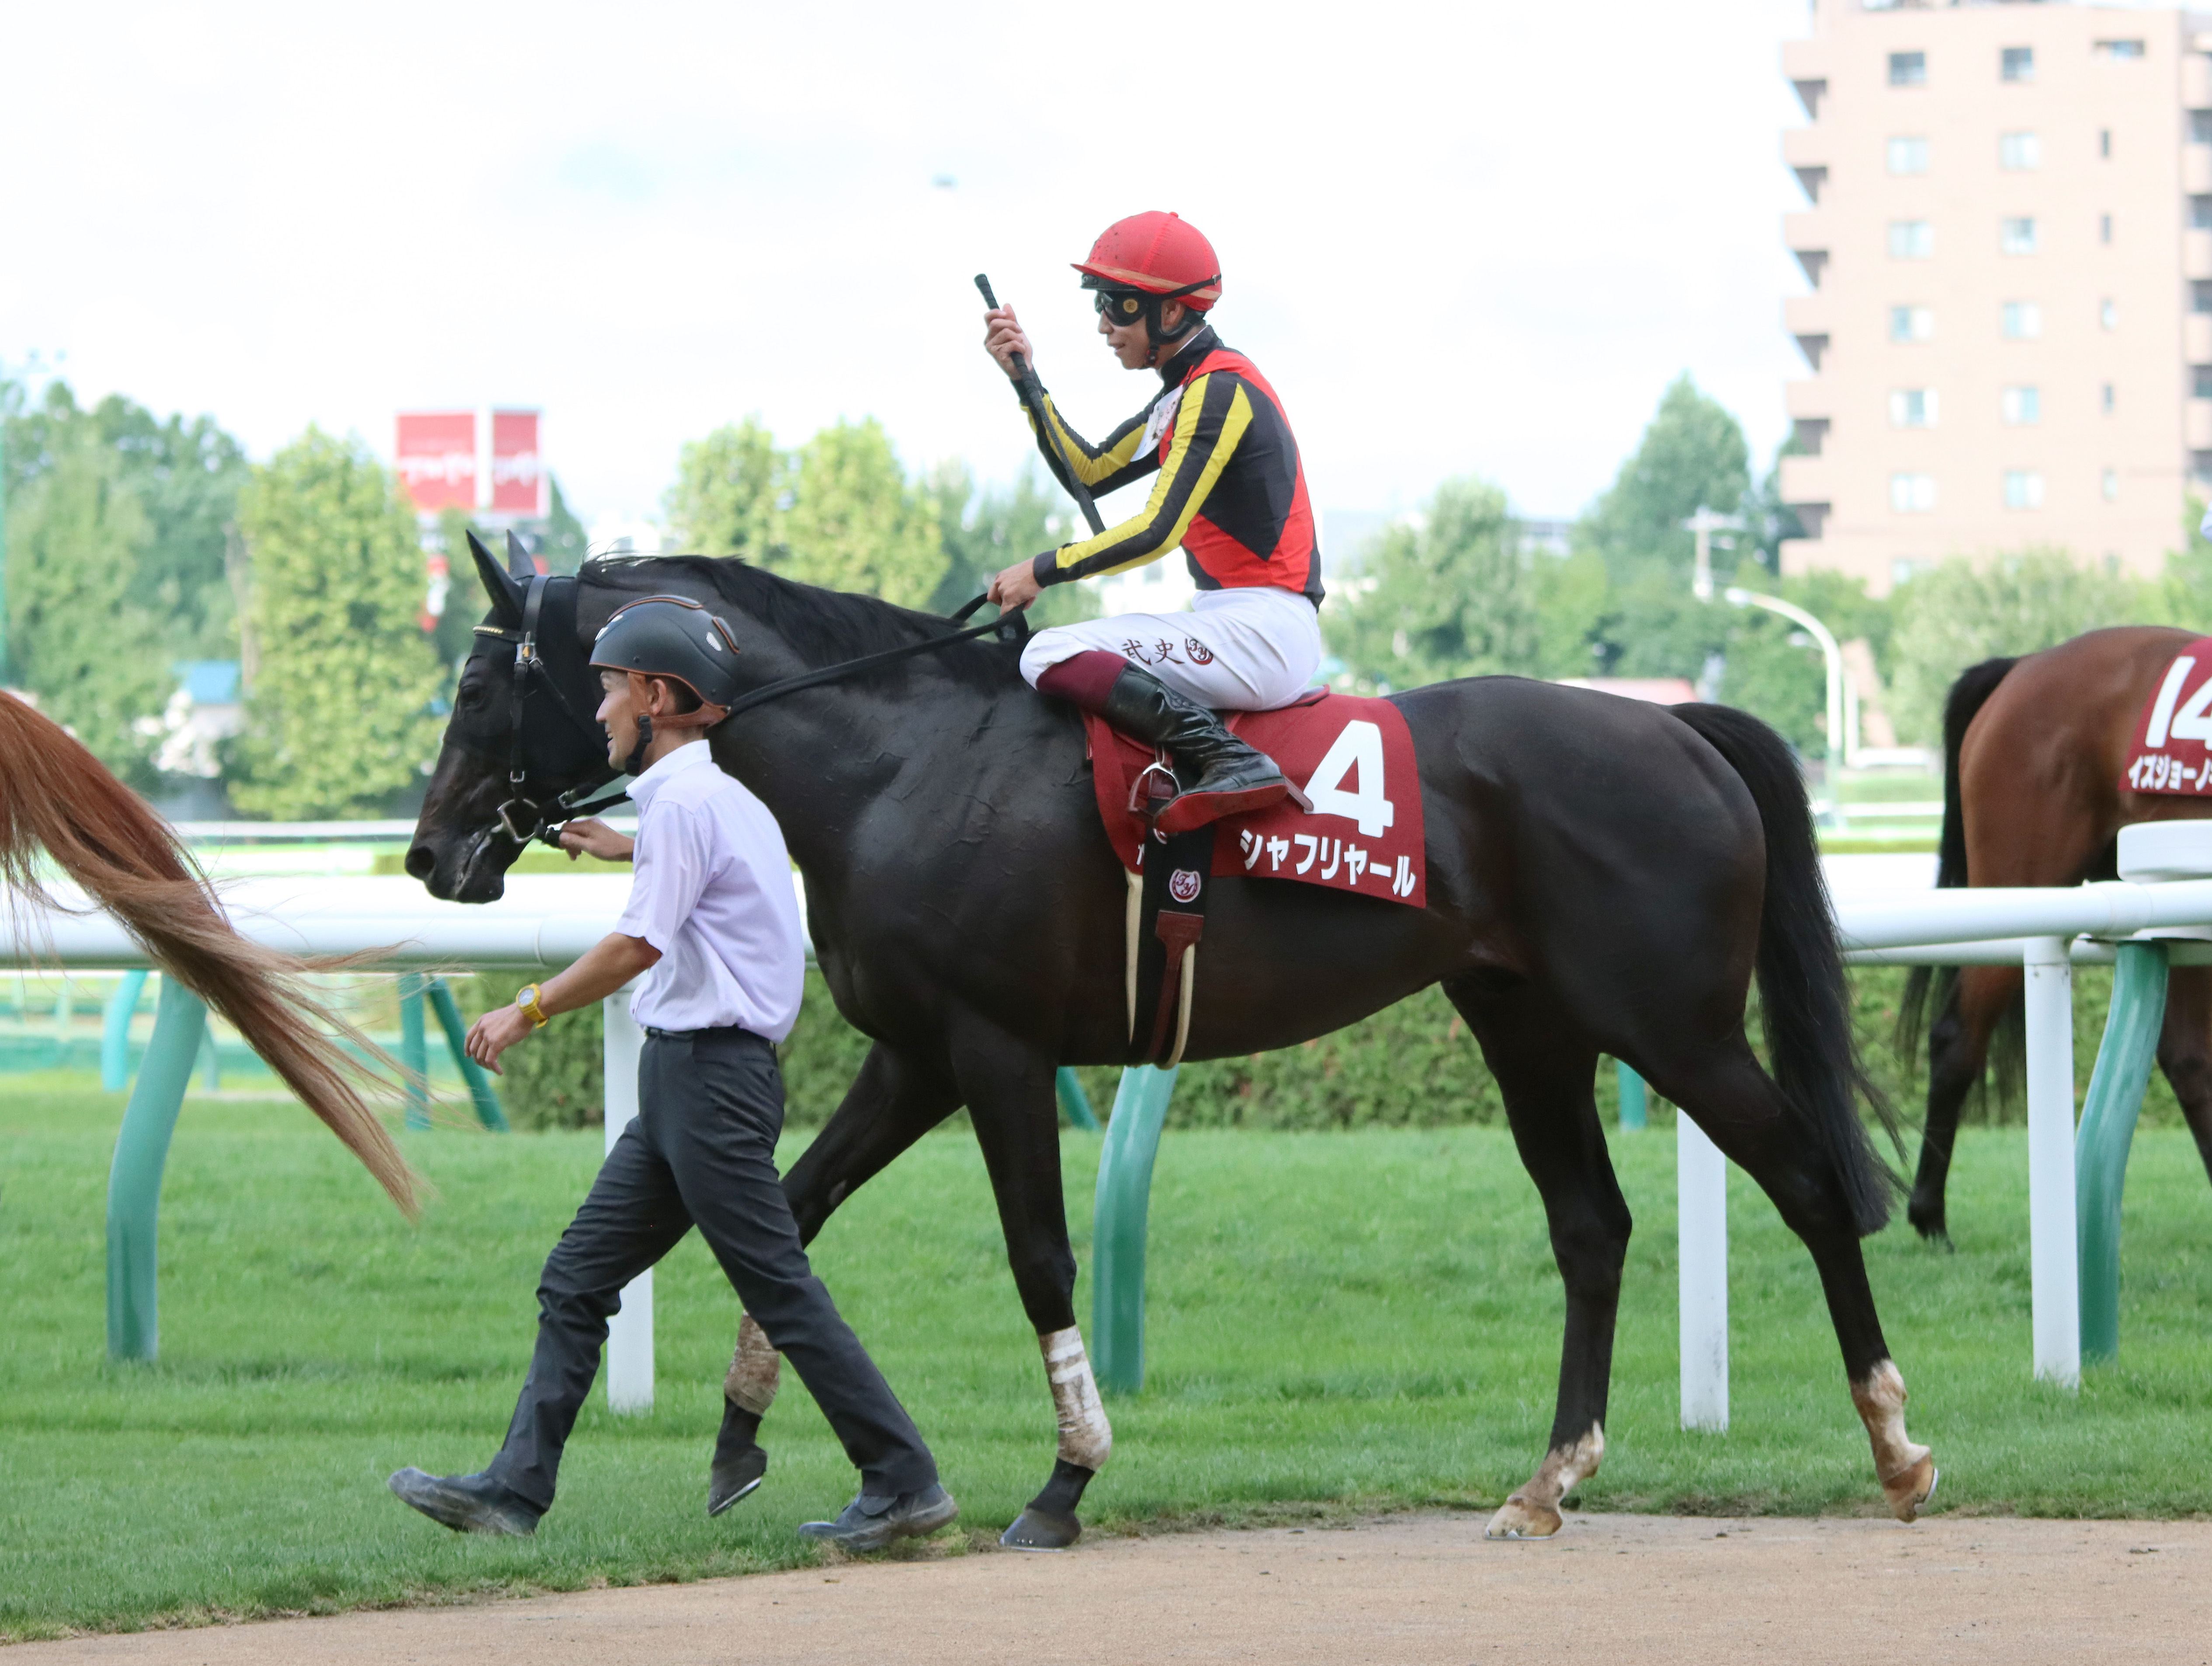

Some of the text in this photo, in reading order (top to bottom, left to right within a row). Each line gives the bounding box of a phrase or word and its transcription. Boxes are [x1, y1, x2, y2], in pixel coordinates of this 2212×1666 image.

[1121, 638, 1185, 666] 武史
[1303, 720, 1394, 838] 4
[2128, 754, 2212, 791] イズジョーノ
[1240, 829, 1416, 897] シャフリヤール
